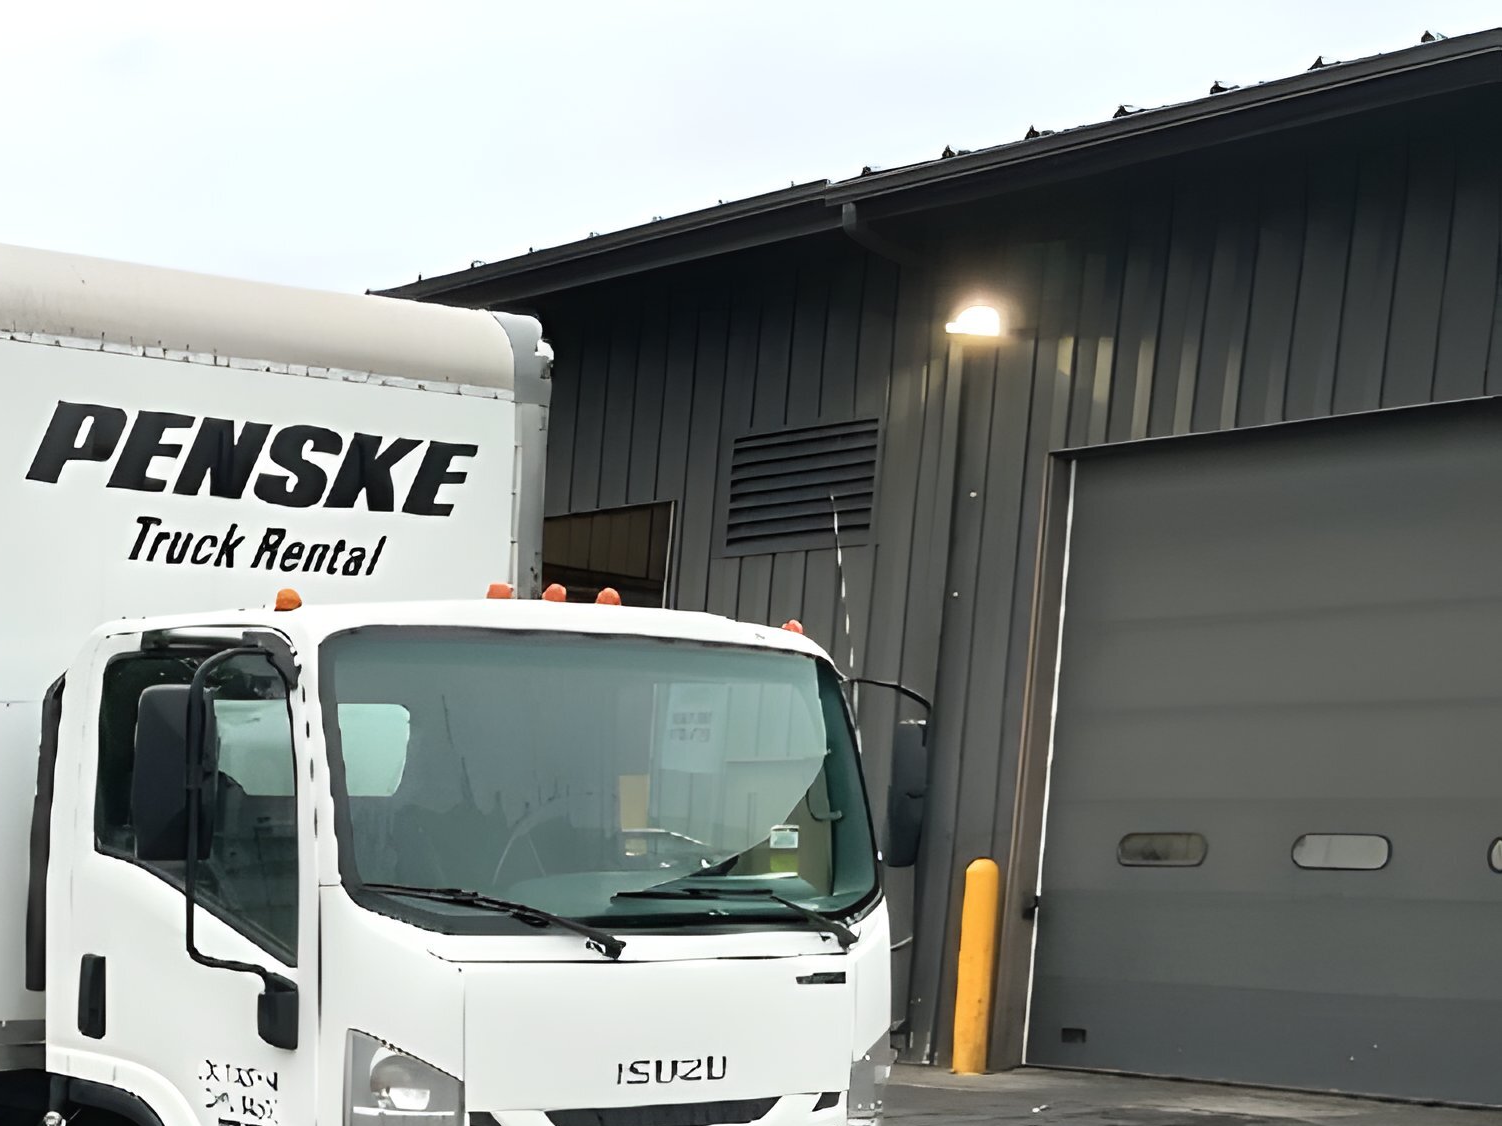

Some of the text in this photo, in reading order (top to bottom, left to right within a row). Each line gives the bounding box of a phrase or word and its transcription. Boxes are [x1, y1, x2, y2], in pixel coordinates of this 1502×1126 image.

[26, 400, 479, 517] PENSKE
[128, 516, 388, 577] Truck Rental
[616, 1055, 727, 1085] ISUZU
